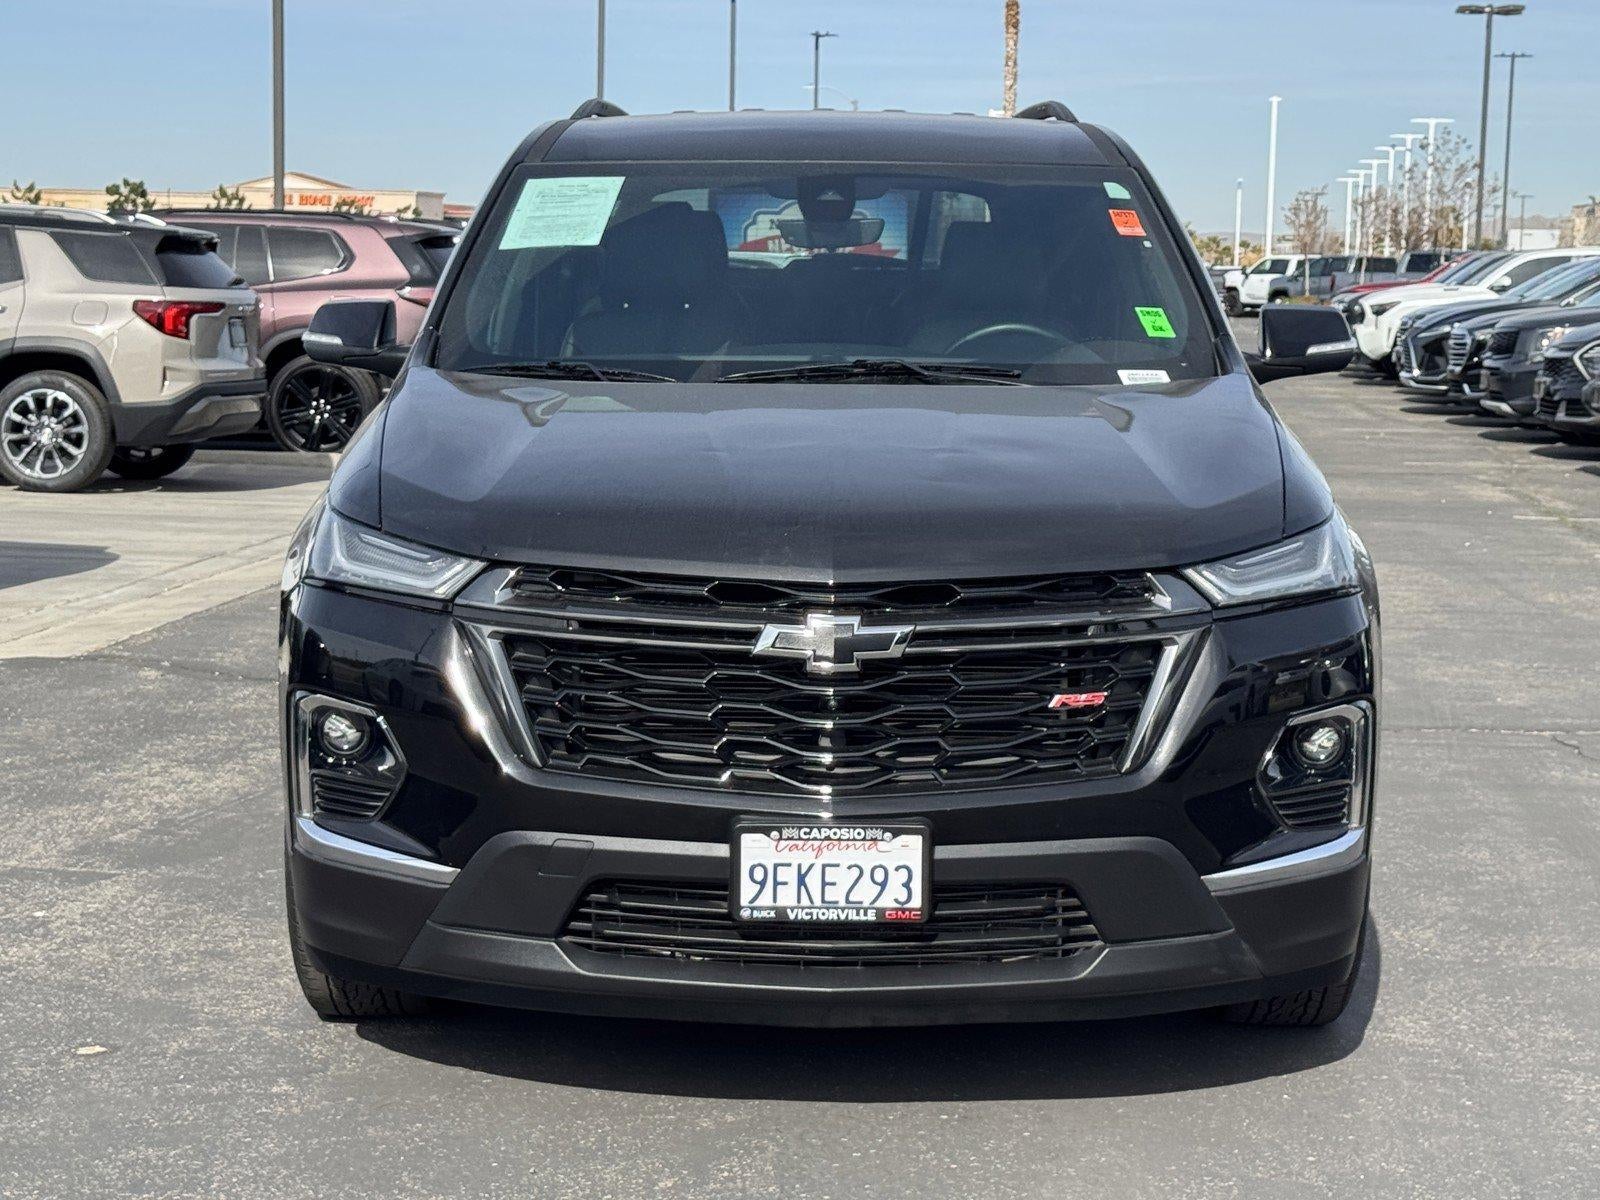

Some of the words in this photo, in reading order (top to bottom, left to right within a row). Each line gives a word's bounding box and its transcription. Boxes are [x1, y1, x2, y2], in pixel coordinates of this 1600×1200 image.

[1048, 691, 1108, 709] RS
[799, 827, 865, 840] CAPOSIO
[748, 862, 913, 906] 9FKE293
[786, 908, 877, 920] VICTORVILLE
[885, 910, 921, 920] GMC
